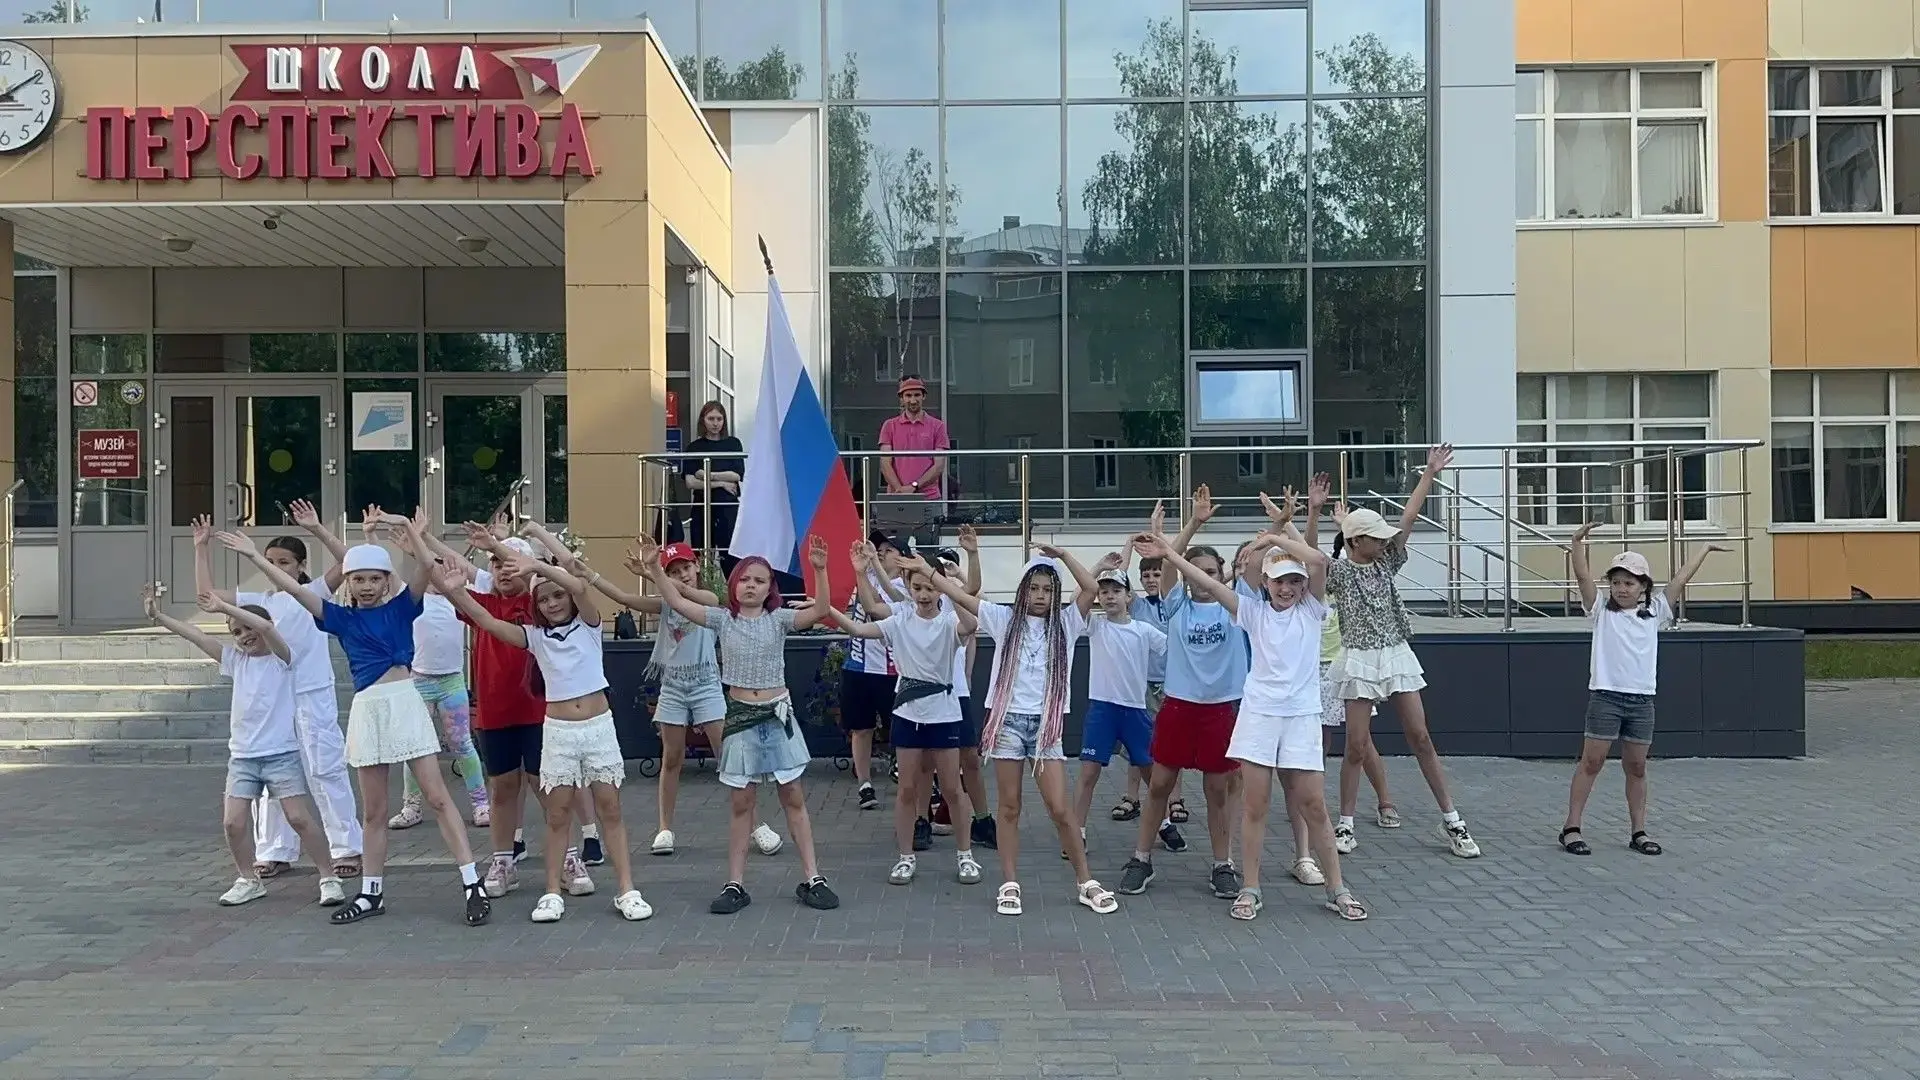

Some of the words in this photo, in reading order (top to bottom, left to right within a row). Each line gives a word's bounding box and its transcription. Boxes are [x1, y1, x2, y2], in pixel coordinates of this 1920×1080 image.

[266, 45, 480, 93] ШКОЛА
[41, 90, 50, 105] 3
[34, 110, 44, 124] 4
[0, 131, 10, 145] 6
[19, 125, 29, 140] 5
[87, 103, 596, 179] ПЕРСПЕКТИВА
[94, 436, 124, 450] МУЗЕЙ
[851, 602, 866, 663] RUIA
